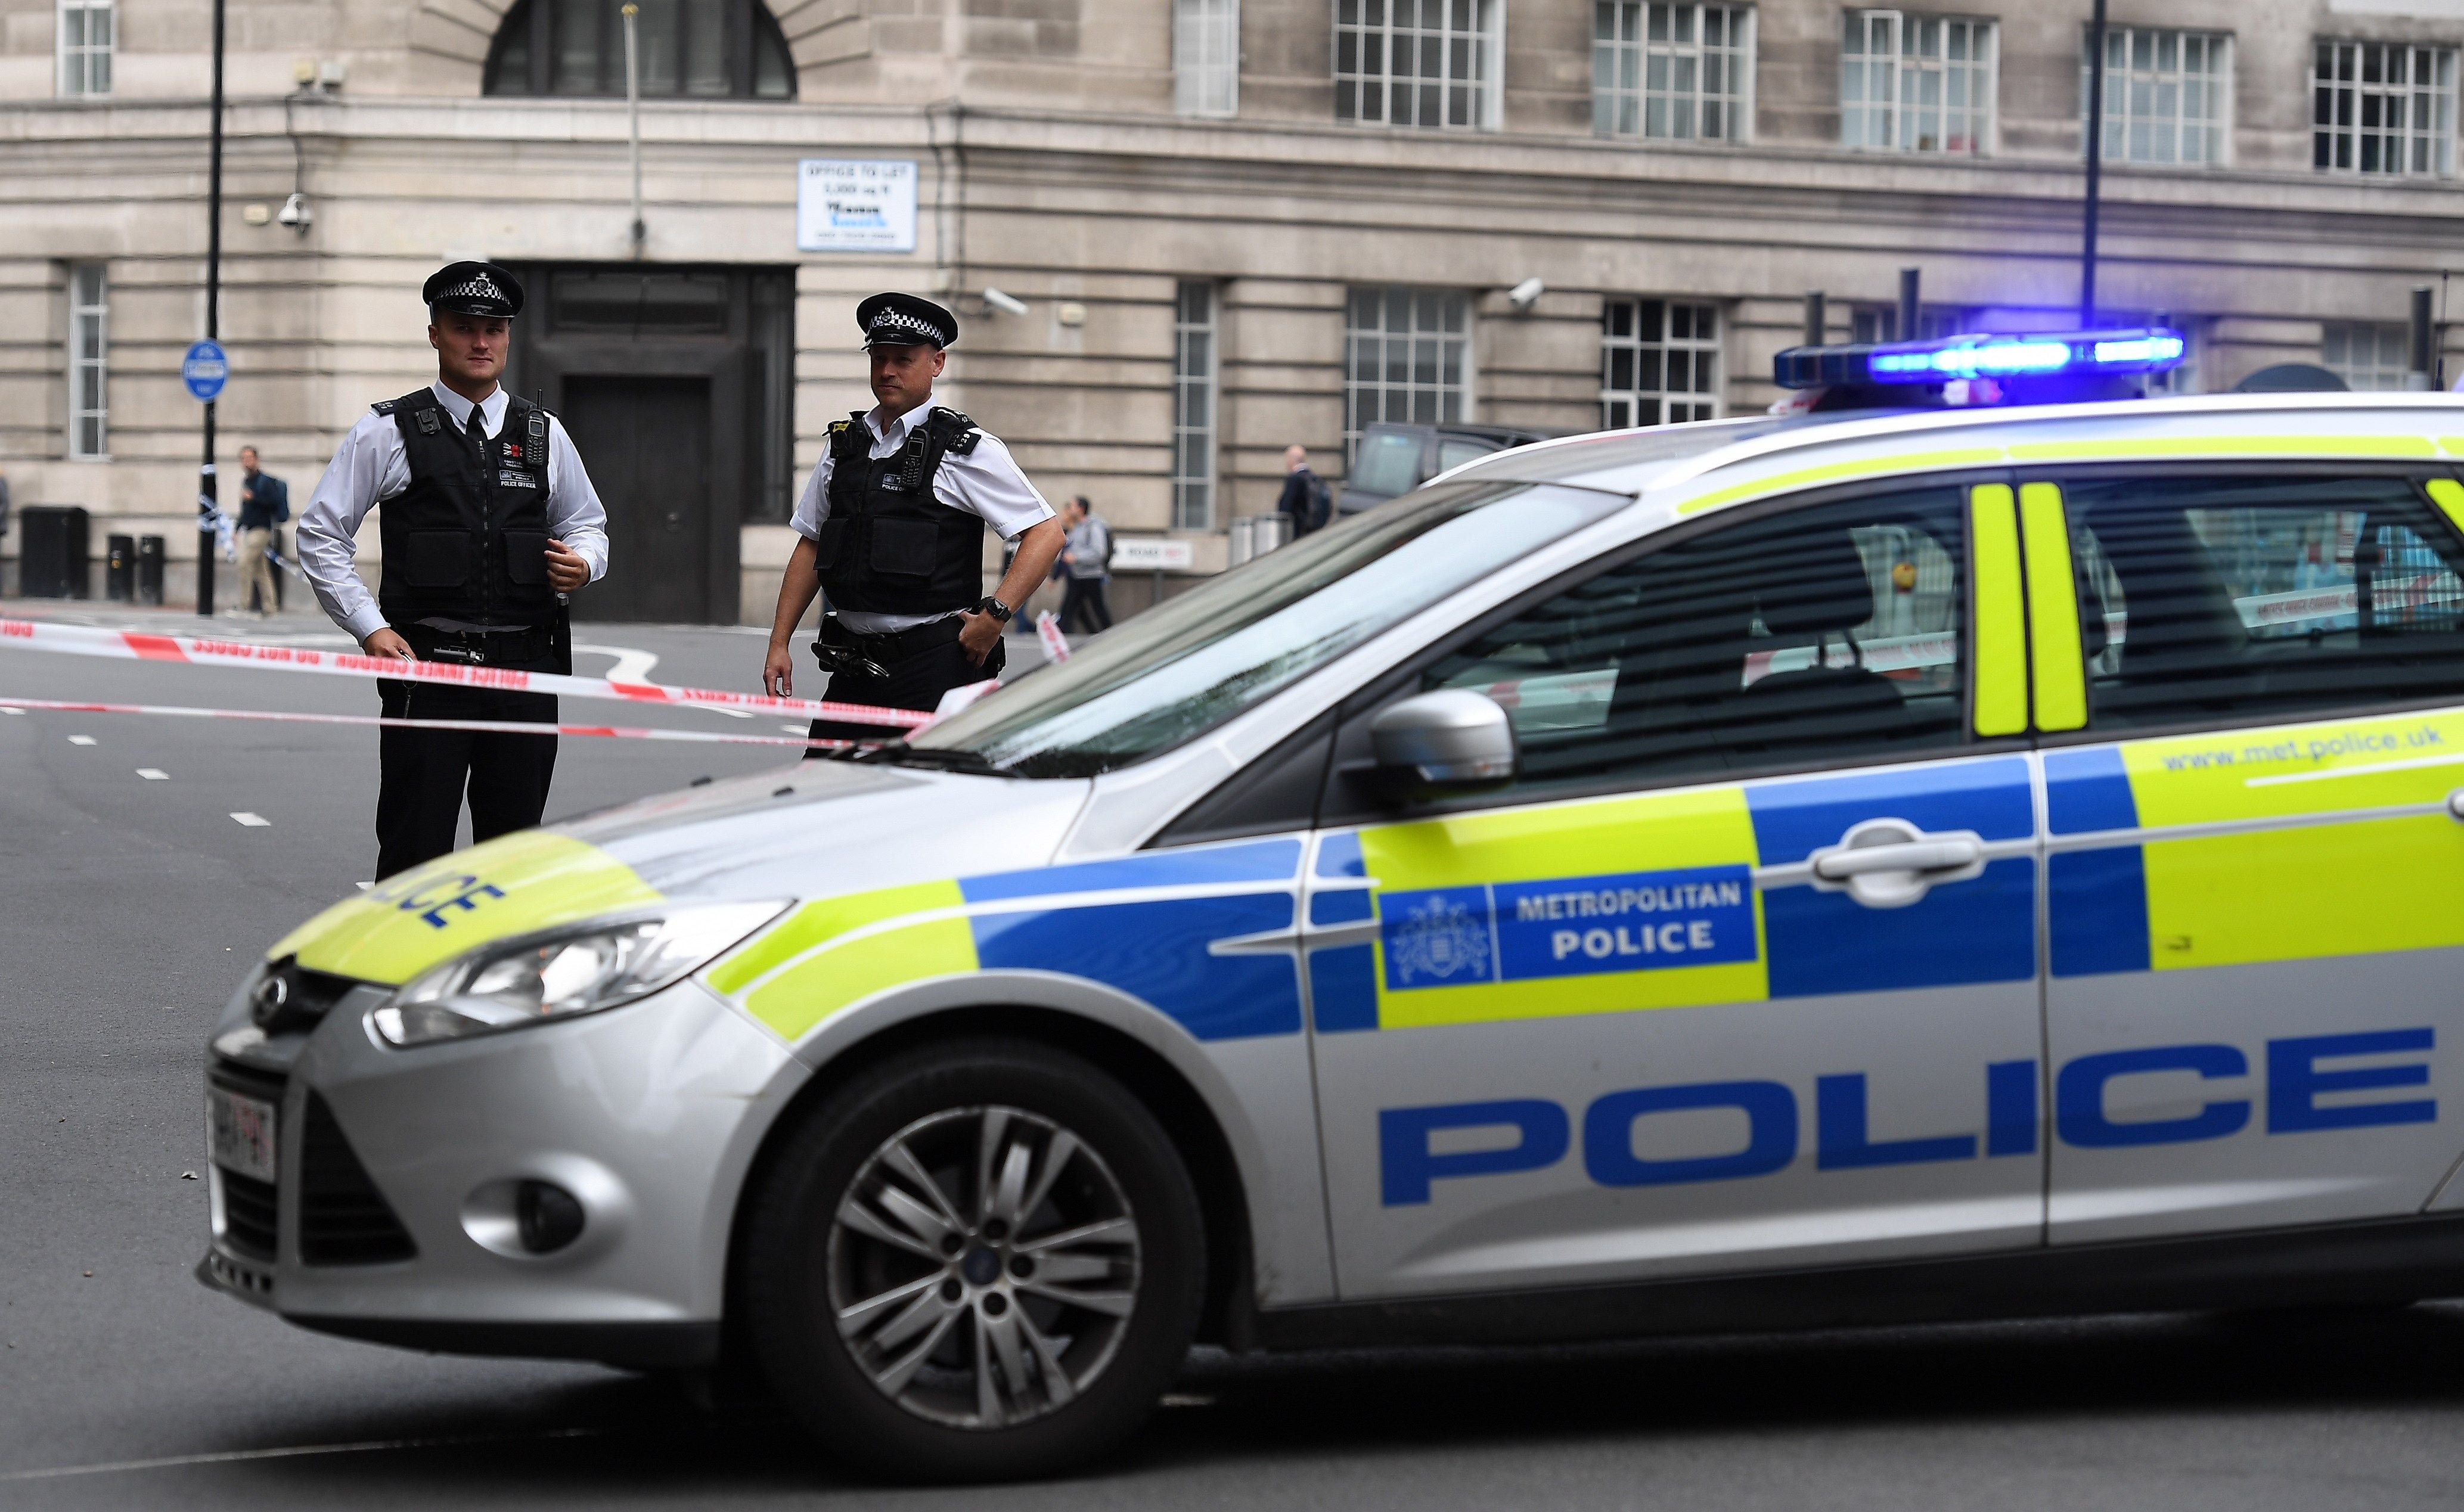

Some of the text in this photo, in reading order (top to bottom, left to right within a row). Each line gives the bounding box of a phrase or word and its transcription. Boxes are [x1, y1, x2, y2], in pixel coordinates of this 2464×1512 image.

[2162, 725, 2443, 771] www.met.police.uk
[1516, 880, 1742, 921] METROPOLITAN
[1551, 920, 1714, 960] POLICE
[1377, 1026, 2438, 1209] POLICE
